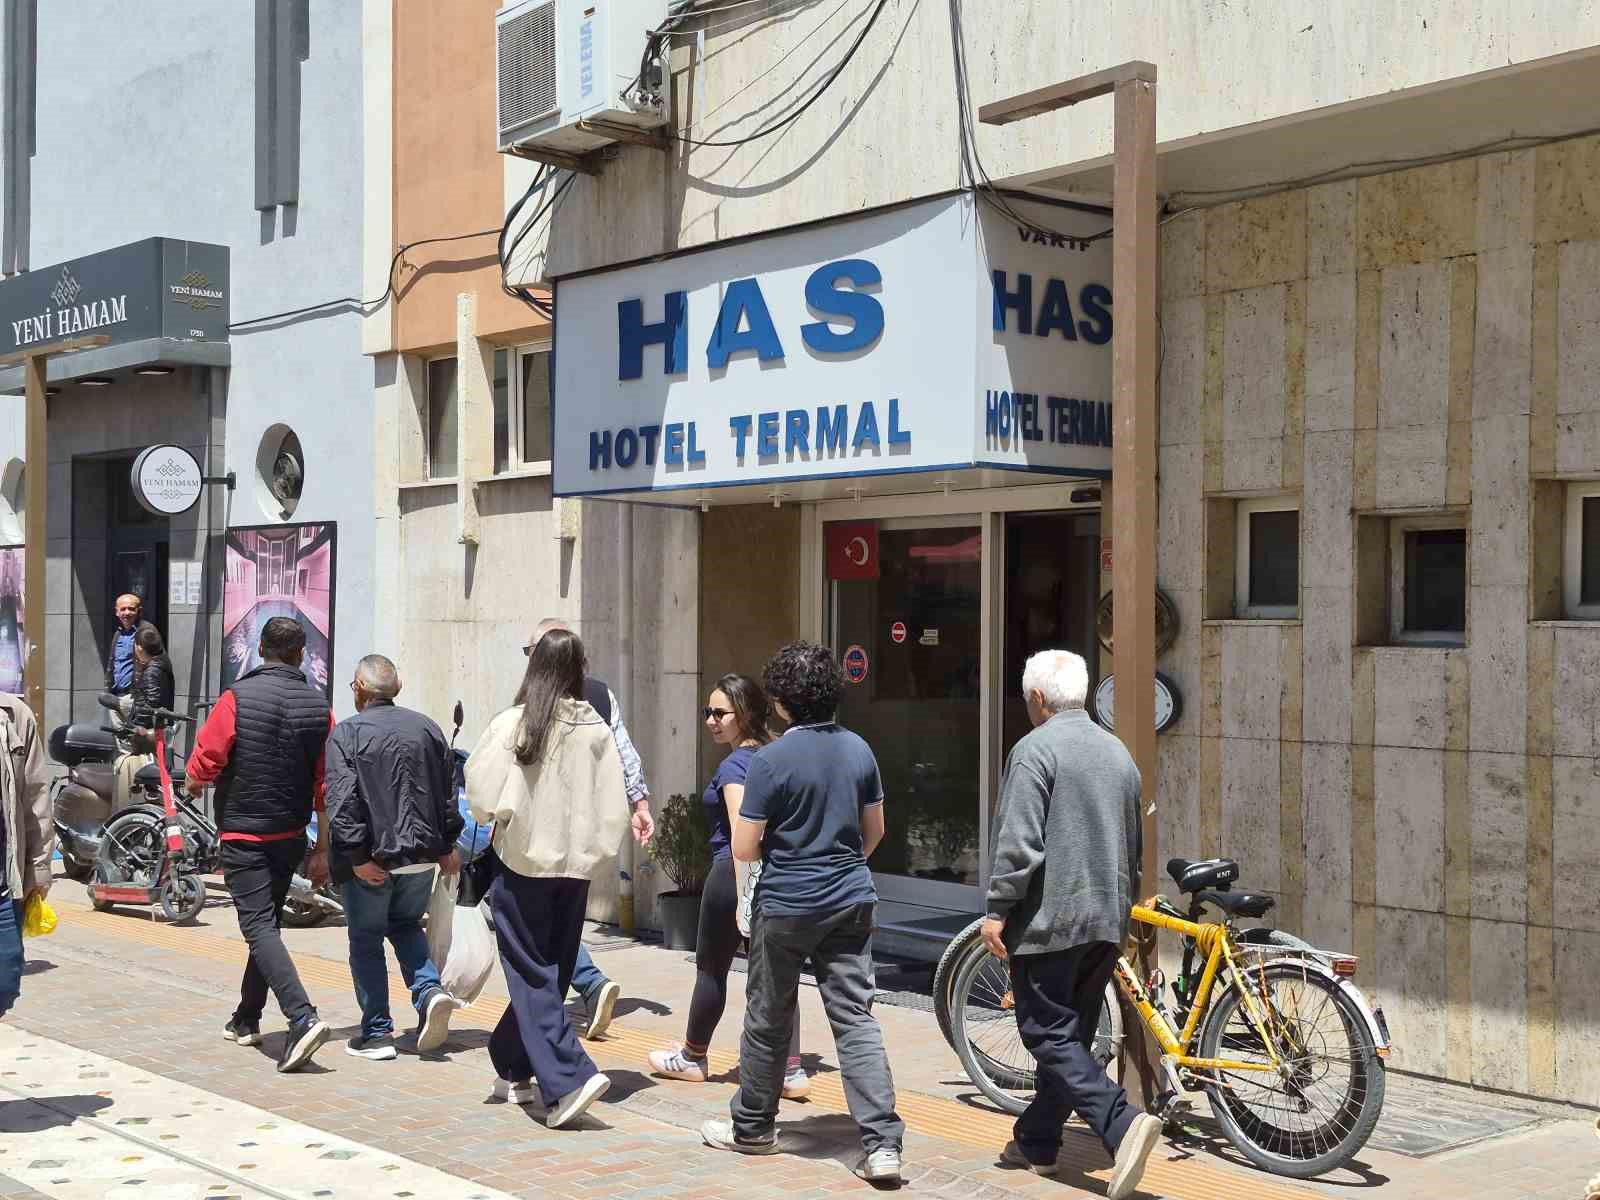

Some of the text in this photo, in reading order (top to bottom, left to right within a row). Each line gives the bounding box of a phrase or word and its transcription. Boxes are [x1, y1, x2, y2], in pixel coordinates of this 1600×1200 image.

[12, 294, 128, 346] YENİ HAMAM
[191, 287, 223, 299] HAMAM
[618, 258, 885, 382] HAS
[992, 269, 1113, 345] HAS
[588, 398, 912, 472] HOTEL TERMAL
[985, 389, 1043, 443] HOTEL
